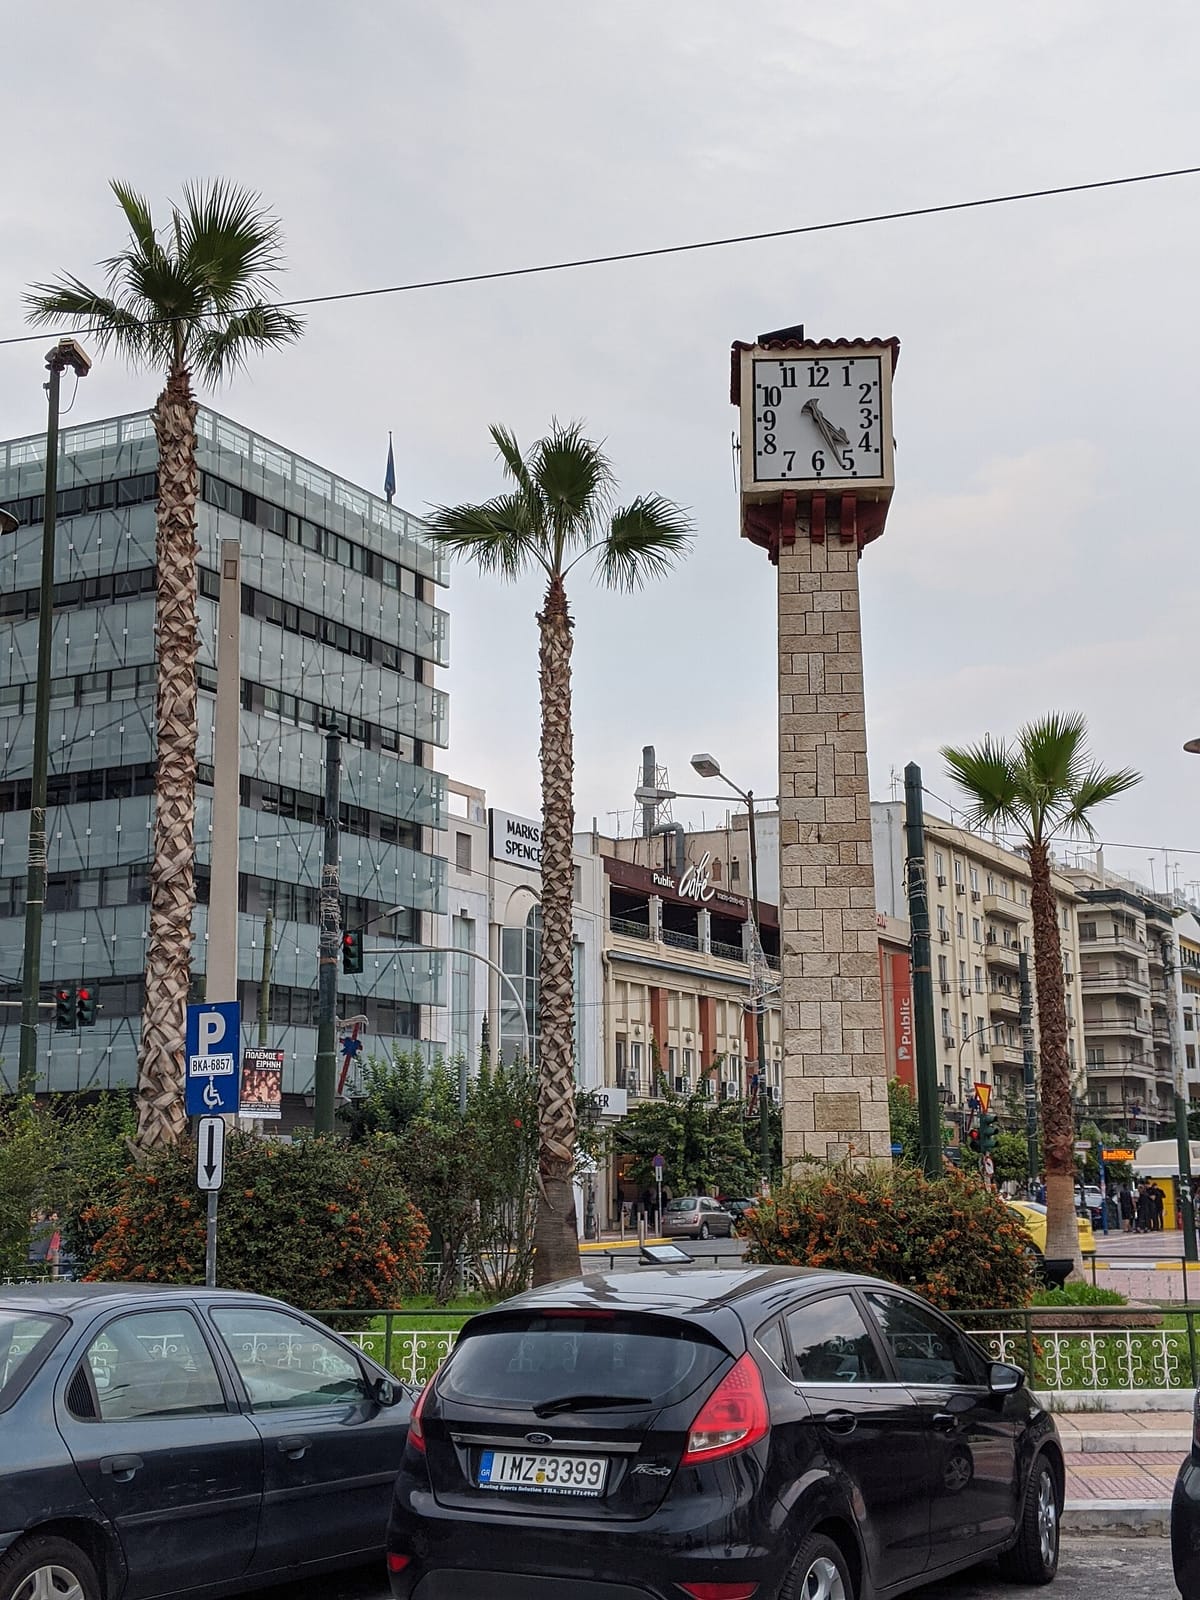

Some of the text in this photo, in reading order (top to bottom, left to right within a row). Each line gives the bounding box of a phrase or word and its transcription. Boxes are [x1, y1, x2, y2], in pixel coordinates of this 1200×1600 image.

[780, 366, 798, 388] 11
[807, 366, 829, 387] 12
[841, 365, 852, 387] 1
[762, 386, 782, 408] 10
[858, 383, 873, 405] 2
[762, 409, 776, 431] 9
[859, 408, 873, 429] 3
[763, 433, 777, 454] 8
[858, 431, 872, 453] 4
[783, 451, 796, 472] 7
[811, 450, 825, 471] 6
[841, 449, 855, 470] 5
[507, 819, 539, 843] MARKS
[505, 840, 543, 863] SPENCE
[653, 873, 675, 889] Public
[900, 997, 912, 1045] Public
[199, 1012, 226, 1056] P
[192, 1058, 231, 1072] BKA-6857
